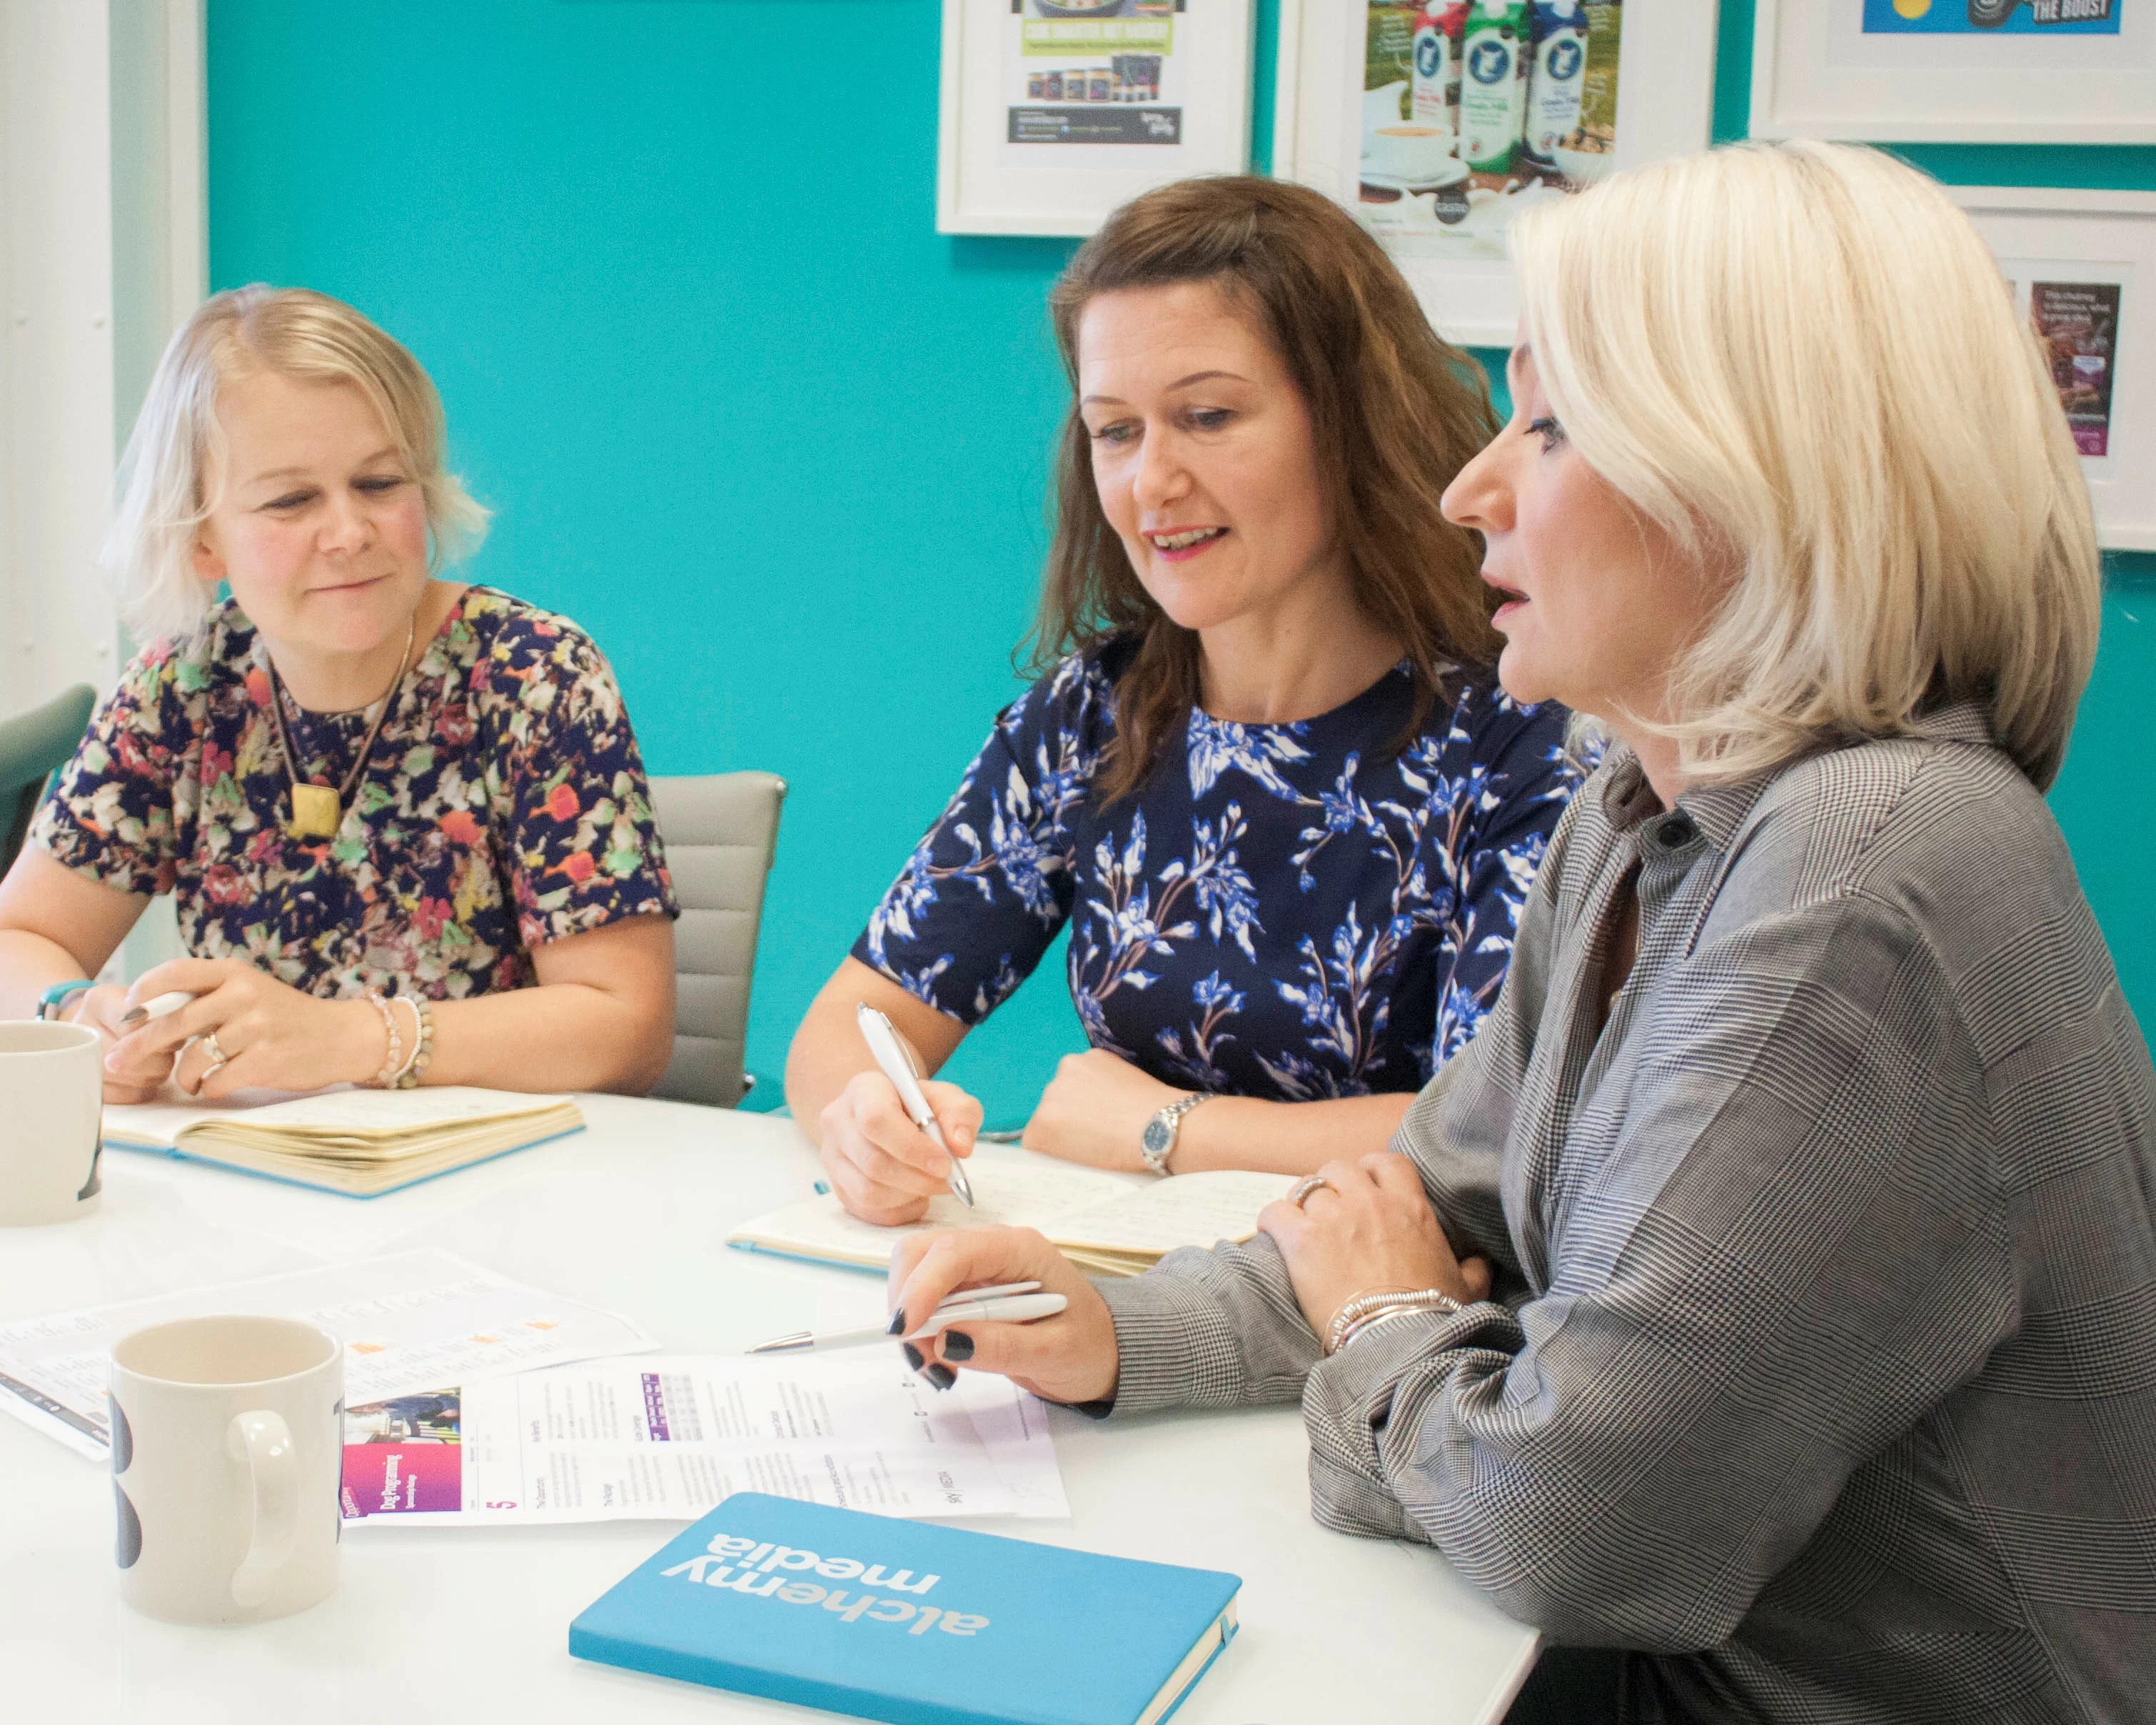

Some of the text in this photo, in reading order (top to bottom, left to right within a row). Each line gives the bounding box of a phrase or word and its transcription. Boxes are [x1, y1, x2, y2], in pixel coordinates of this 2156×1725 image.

[2032, 0, 2109, 20] THE BOOST
[380, 1495, 401, 1510] Dog
[486, 1501, 518, 1509] 5
[705, 1533, 941, 1595] media
[660, 1555, 992, 1636] alchemy
